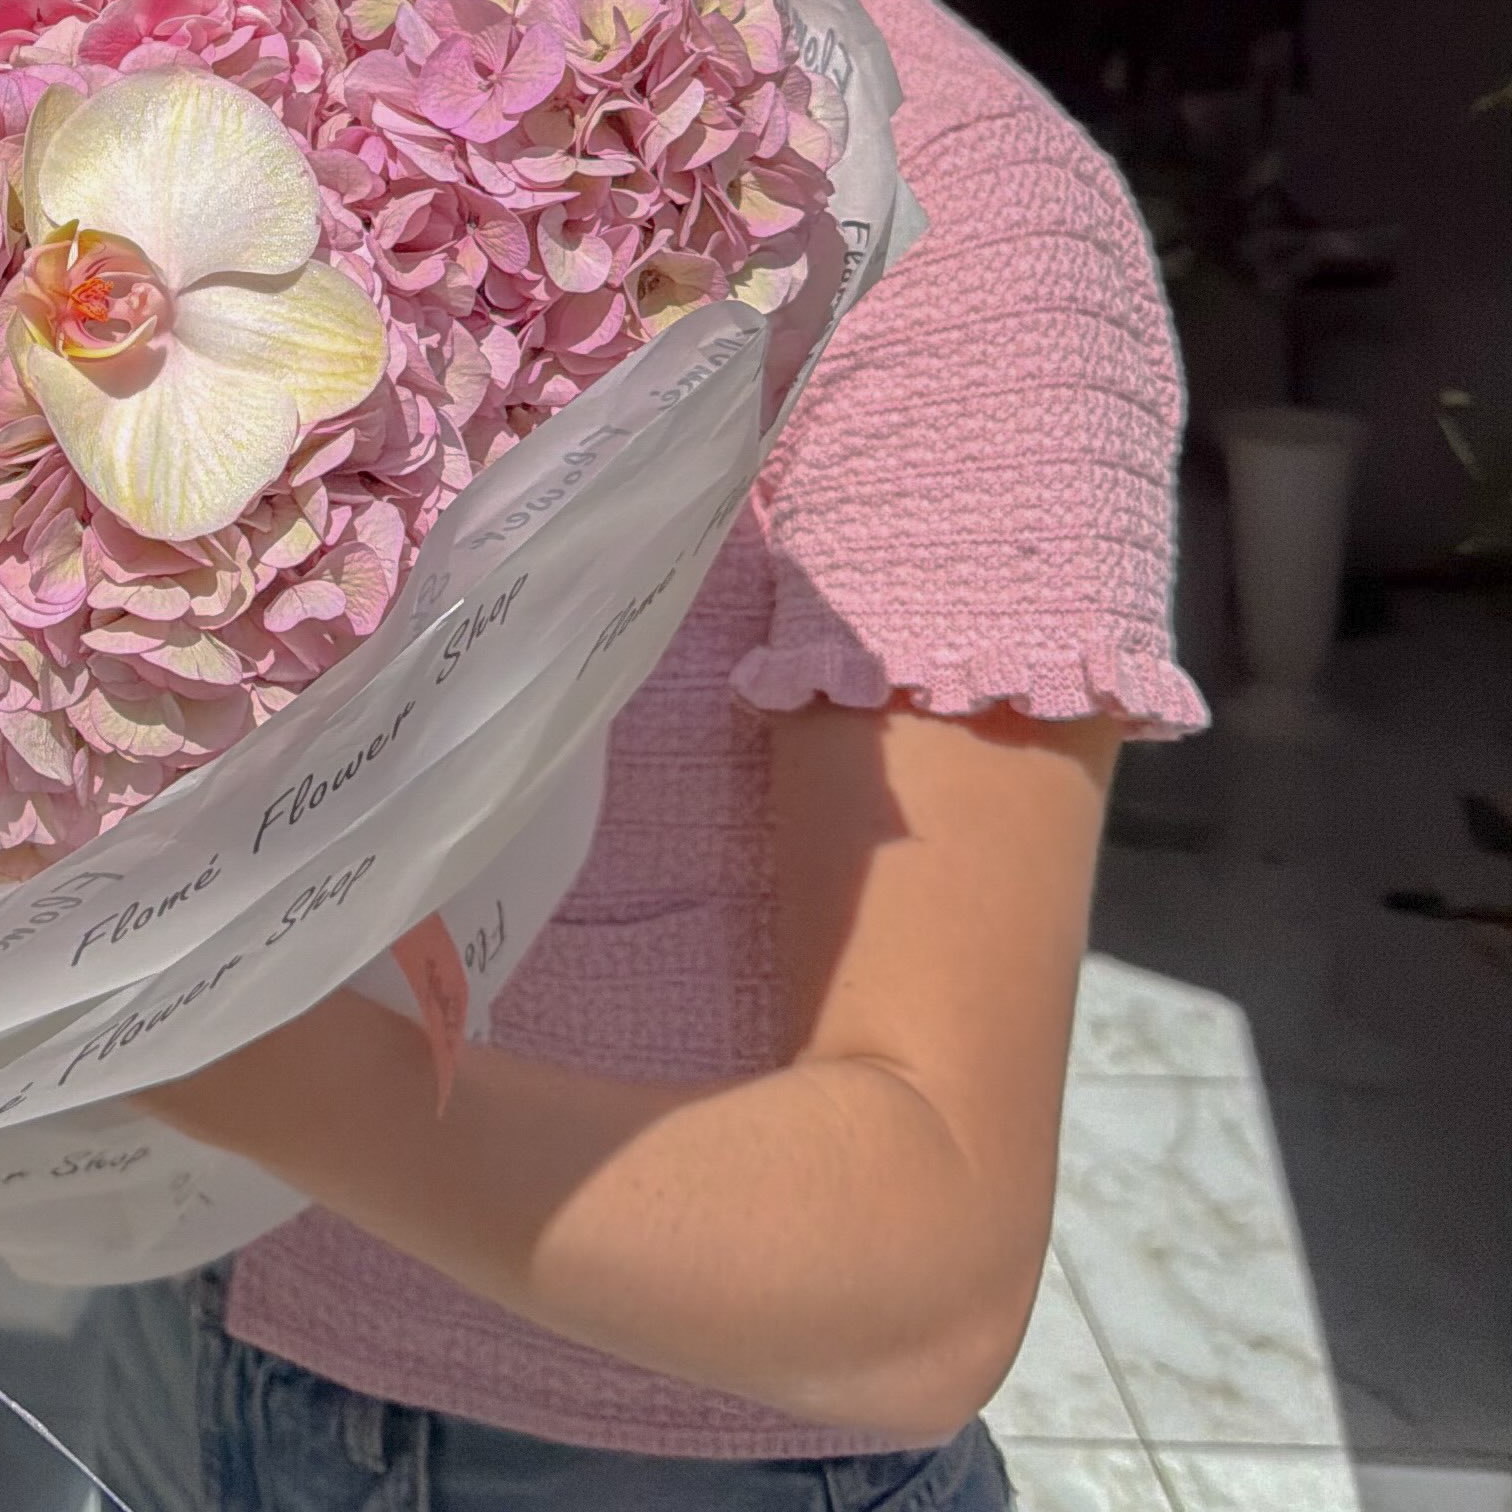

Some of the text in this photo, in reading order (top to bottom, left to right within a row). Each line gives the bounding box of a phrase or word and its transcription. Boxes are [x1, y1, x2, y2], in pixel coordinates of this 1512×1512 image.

[71, 854, 222, 966] Flomé
[252, 699, 416, 855] Flower
[435, 572, 529, 685] Shop
[58, 952, 242, 1087] Flower
[264, 854, 377, 947] Shop
